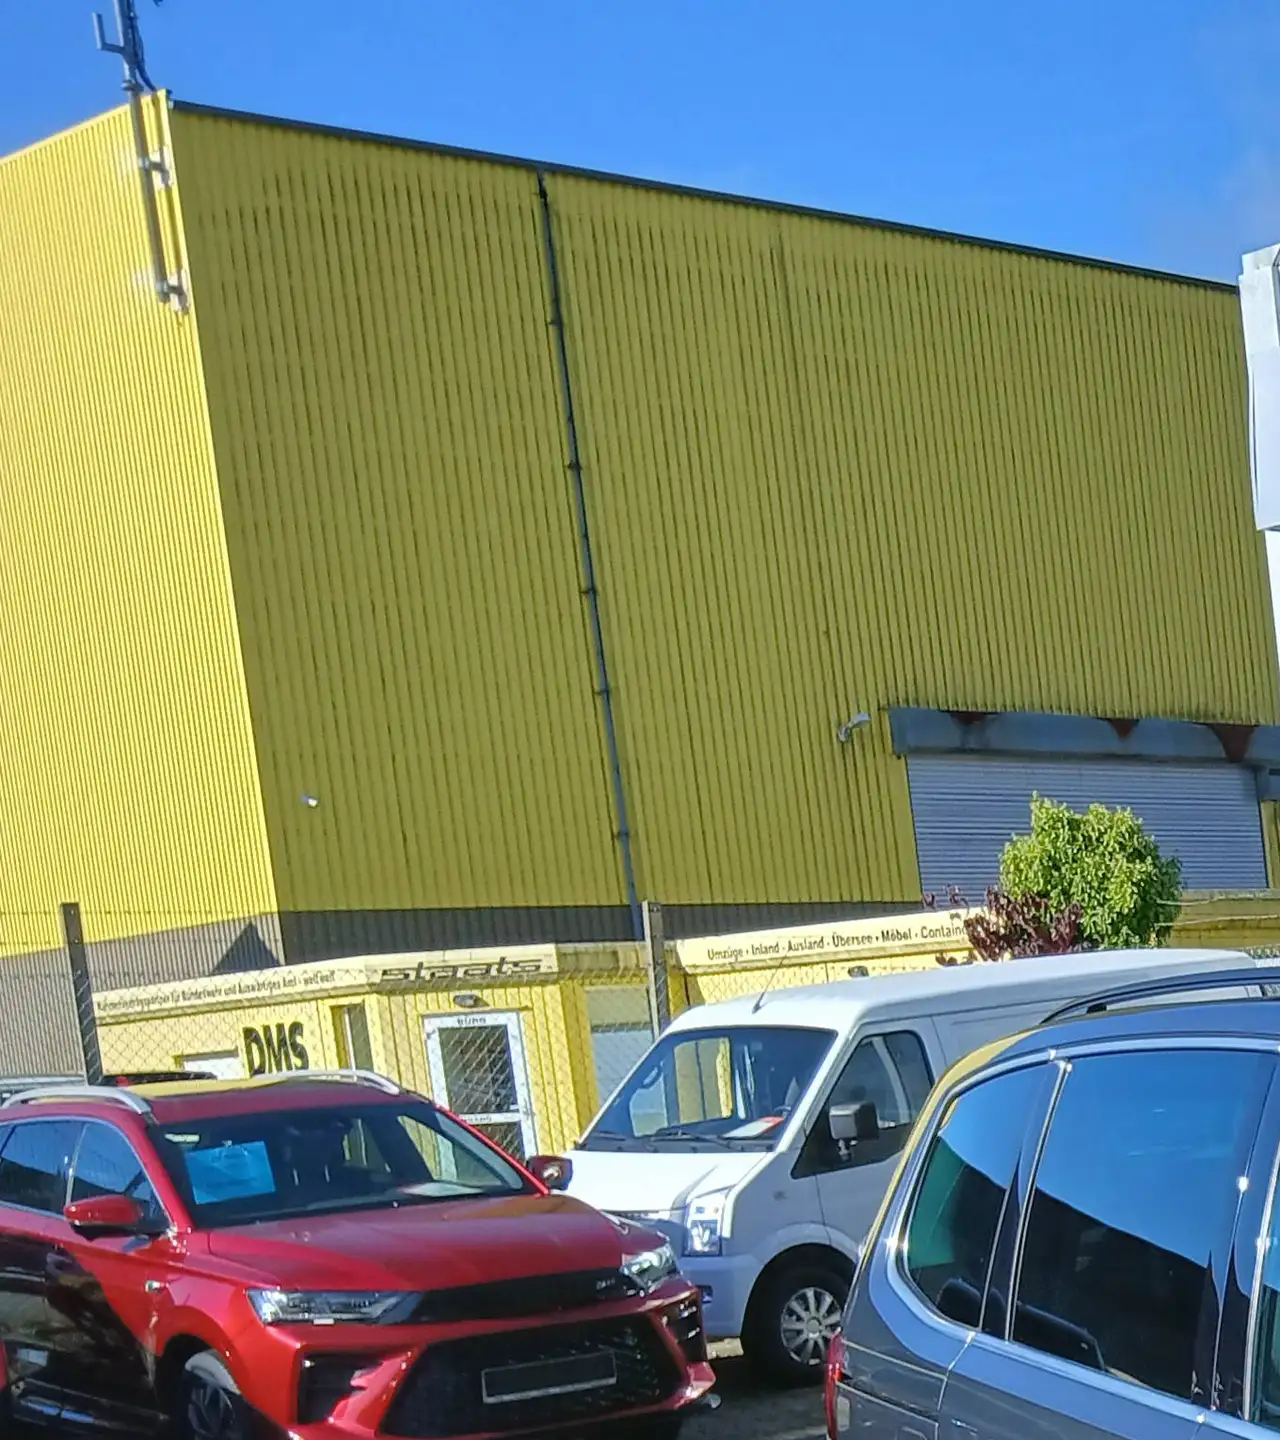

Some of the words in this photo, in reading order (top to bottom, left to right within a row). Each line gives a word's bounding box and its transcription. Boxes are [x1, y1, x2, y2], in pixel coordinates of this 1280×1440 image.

[707, 945, 744, 961] Umzüge
[751, 941, 780, 956] Inland
[787, 936, 825, 952] Ausland
[831, 931, 873, 948] Übersee
[881, 927, 912, 943] Möbel
[242, 1020, 309, 1079] DMS
